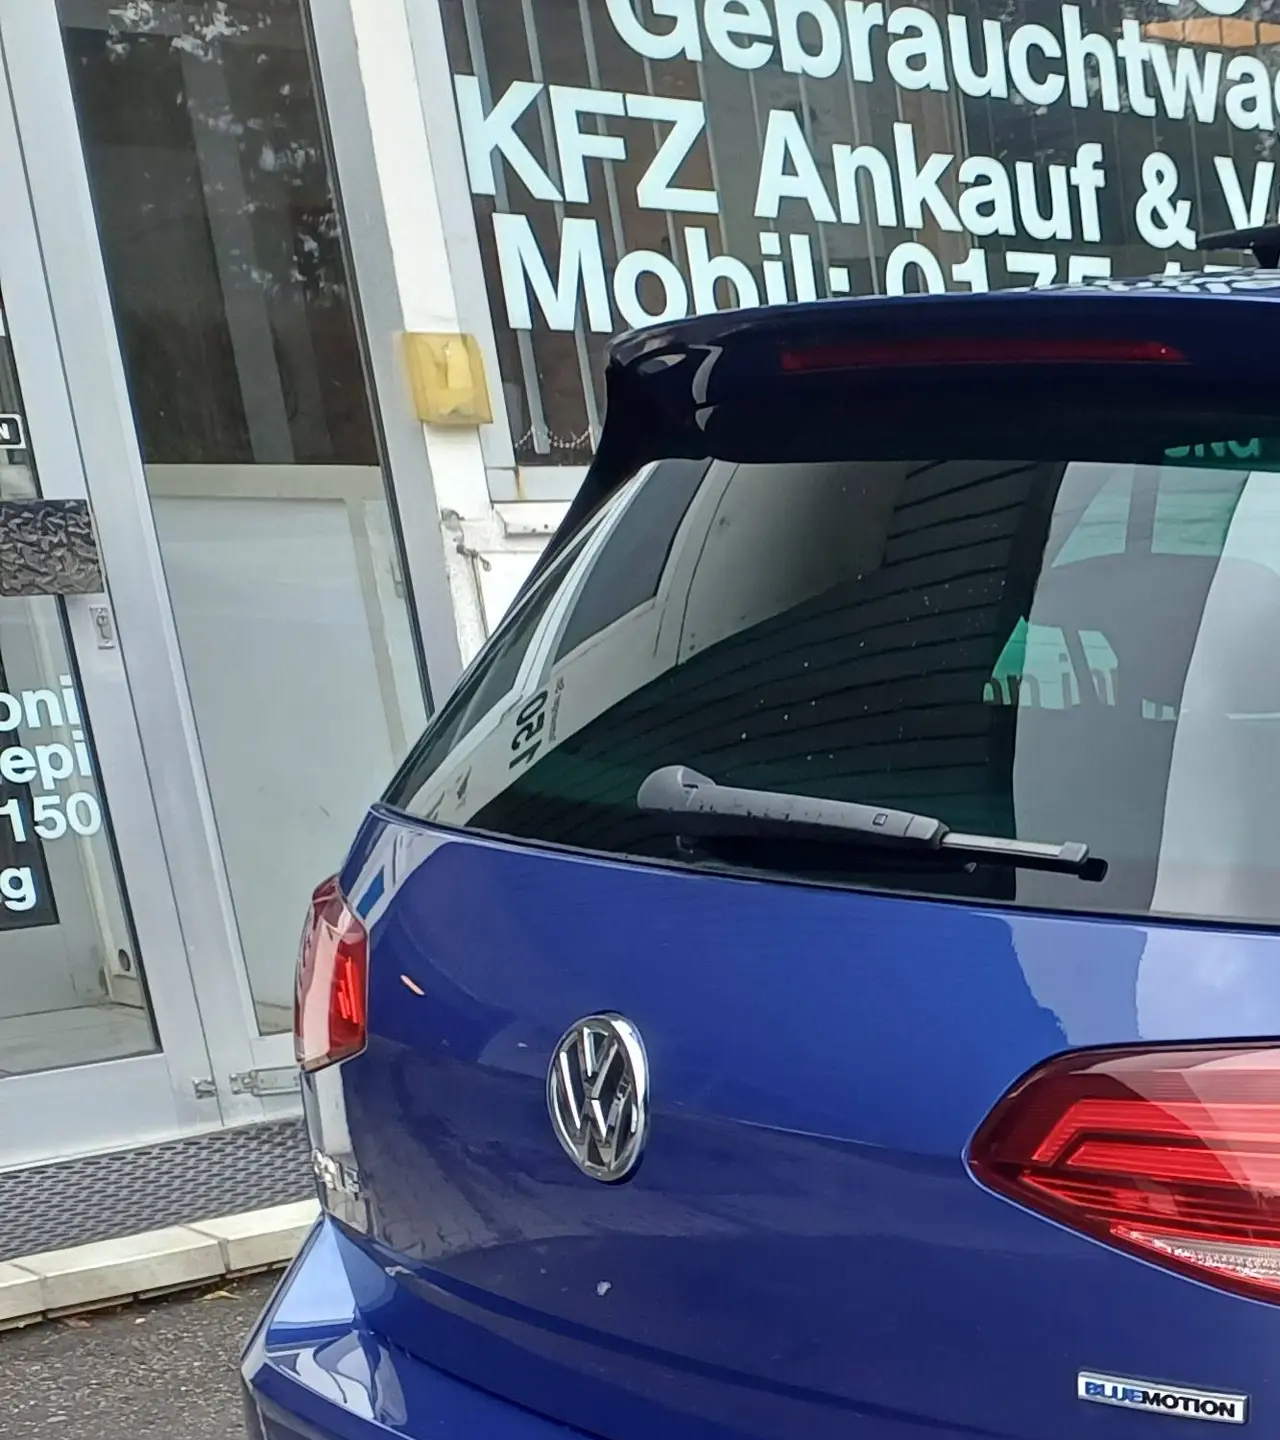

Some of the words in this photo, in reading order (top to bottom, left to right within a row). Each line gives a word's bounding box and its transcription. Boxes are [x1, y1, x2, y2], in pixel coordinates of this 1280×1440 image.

[453, 73, 720, 214] KFZ
[754, 108, 1106, 243] Ankauf
[1135, 151, 1198, 251] &
[1084, 1381, 1236, 1418] BLUEMOTION
